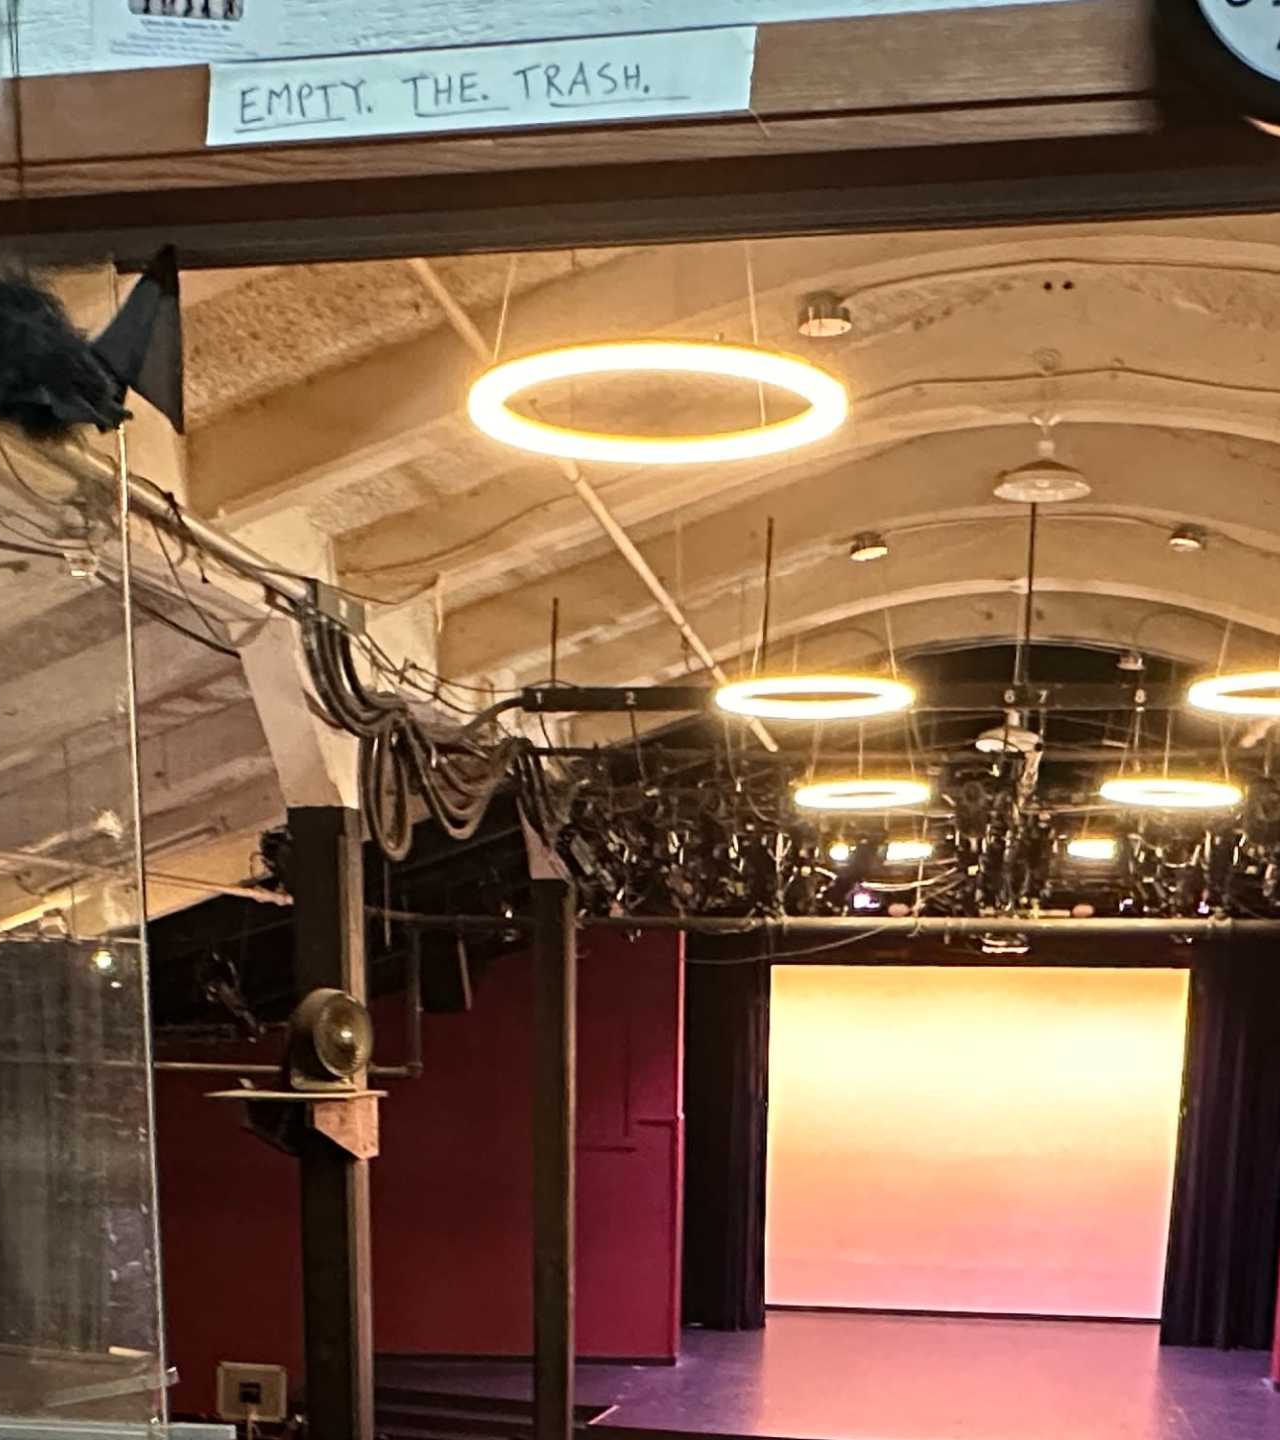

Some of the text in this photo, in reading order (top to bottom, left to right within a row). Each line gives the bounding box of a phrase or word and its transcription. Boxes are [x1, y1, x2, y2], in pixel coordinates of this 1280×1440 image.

[403, 72, 489, 116] THE.
[514, 62, 651, 99] TRASH.
[625, 691, 637, 705] 2
[1004, 689, 1015, 703] 6
[1037, 689, 1048, 704] 7
[1134, 689, 1146, 703] 8
